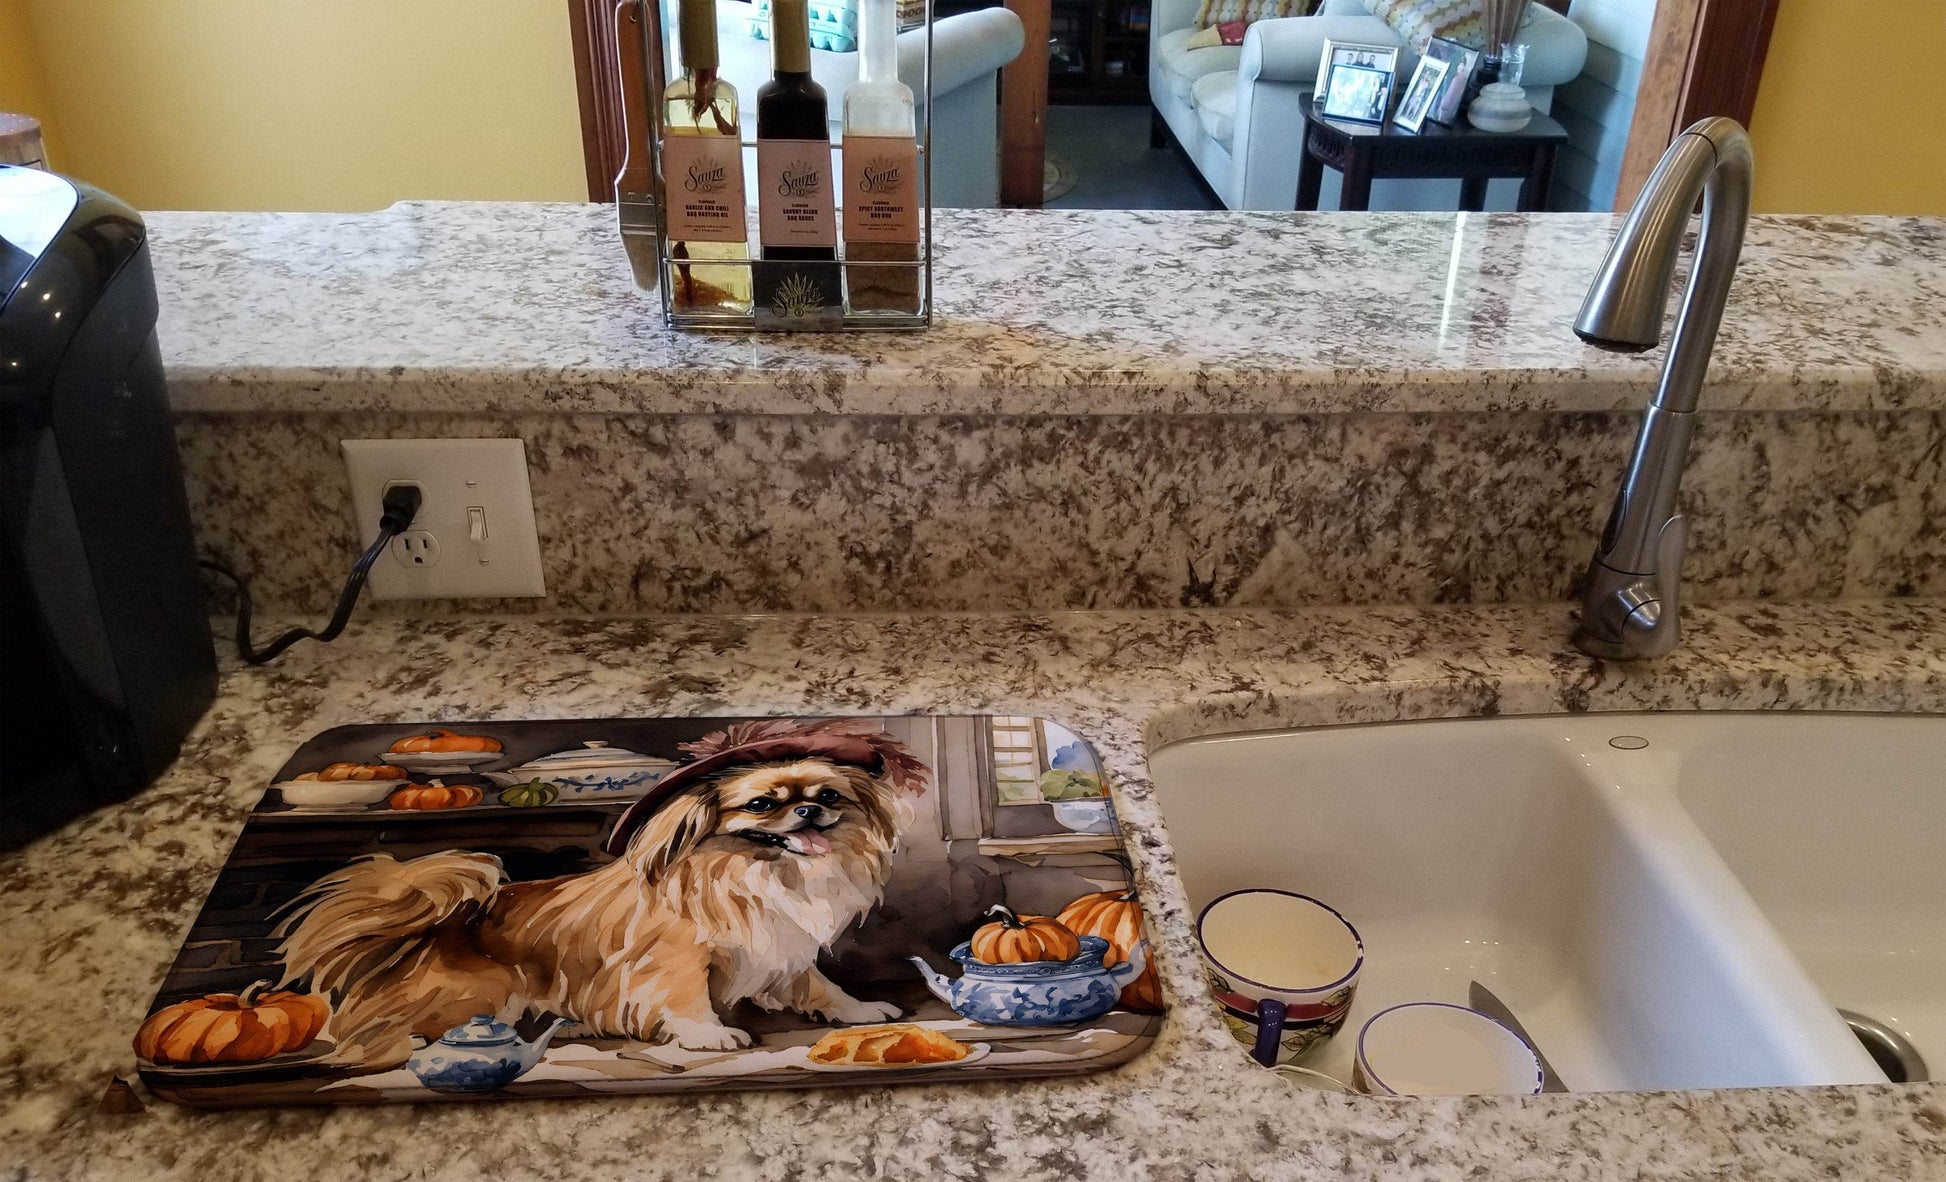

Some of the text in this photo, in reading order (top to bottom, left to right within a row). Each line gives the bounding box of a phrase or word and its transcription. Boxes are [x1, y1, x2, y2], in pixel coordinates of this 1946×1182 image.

[684, 165, 726, 192] Sauza
[778, 171, 818, 197] Sauza
[860, 166, 900, 193] Sauza
[771, 288, 821, 317] Sauza
